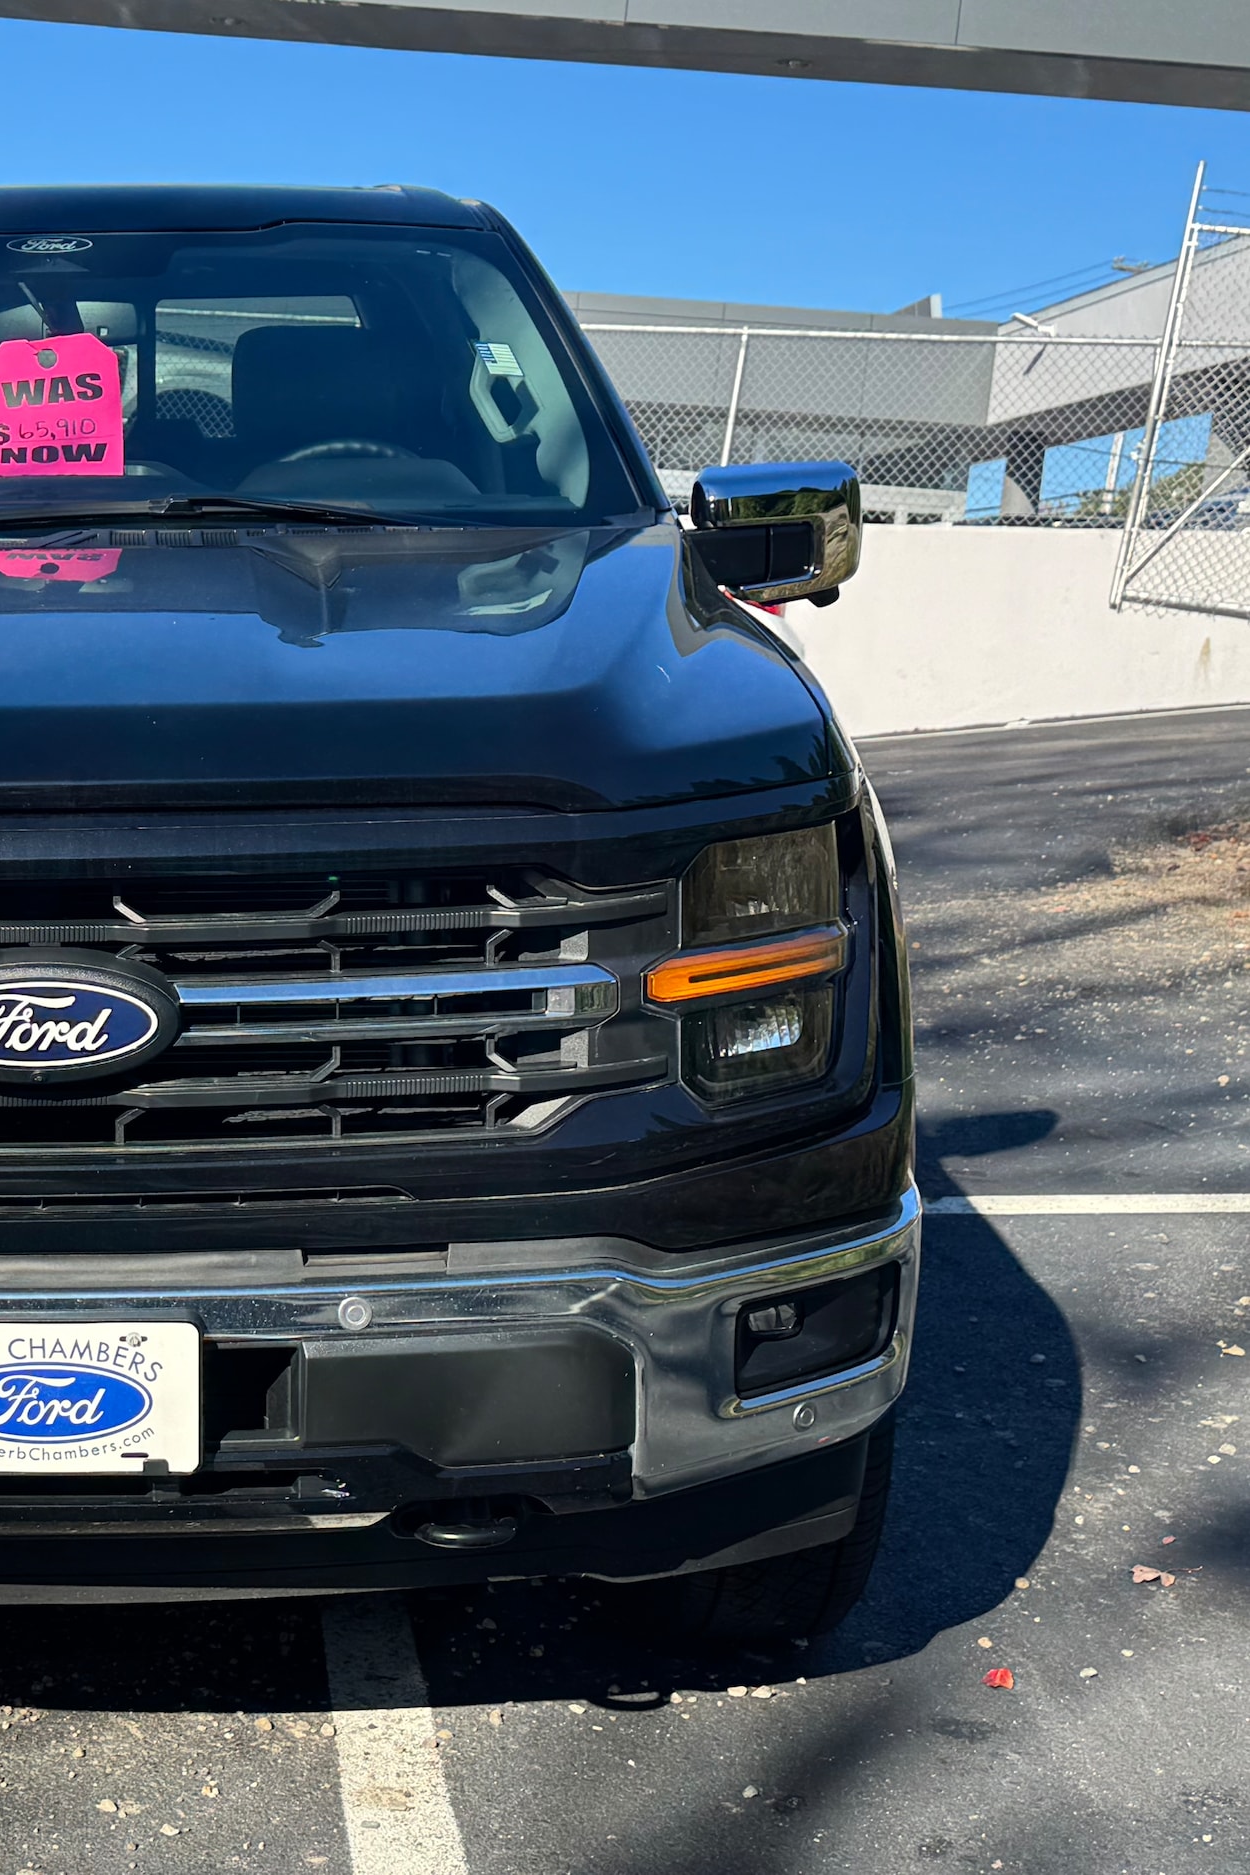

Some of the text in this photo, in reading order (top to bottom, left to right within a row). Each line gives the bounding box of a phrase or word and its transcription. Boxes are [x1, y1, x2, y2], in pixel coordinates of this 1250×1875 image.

[21, 238, 77, 251] Ford
[1, 373, 103, 408] WAS
[0, 443, 108, 464] NOW
[8, 1338, 163, 1383] CHAMBERS
